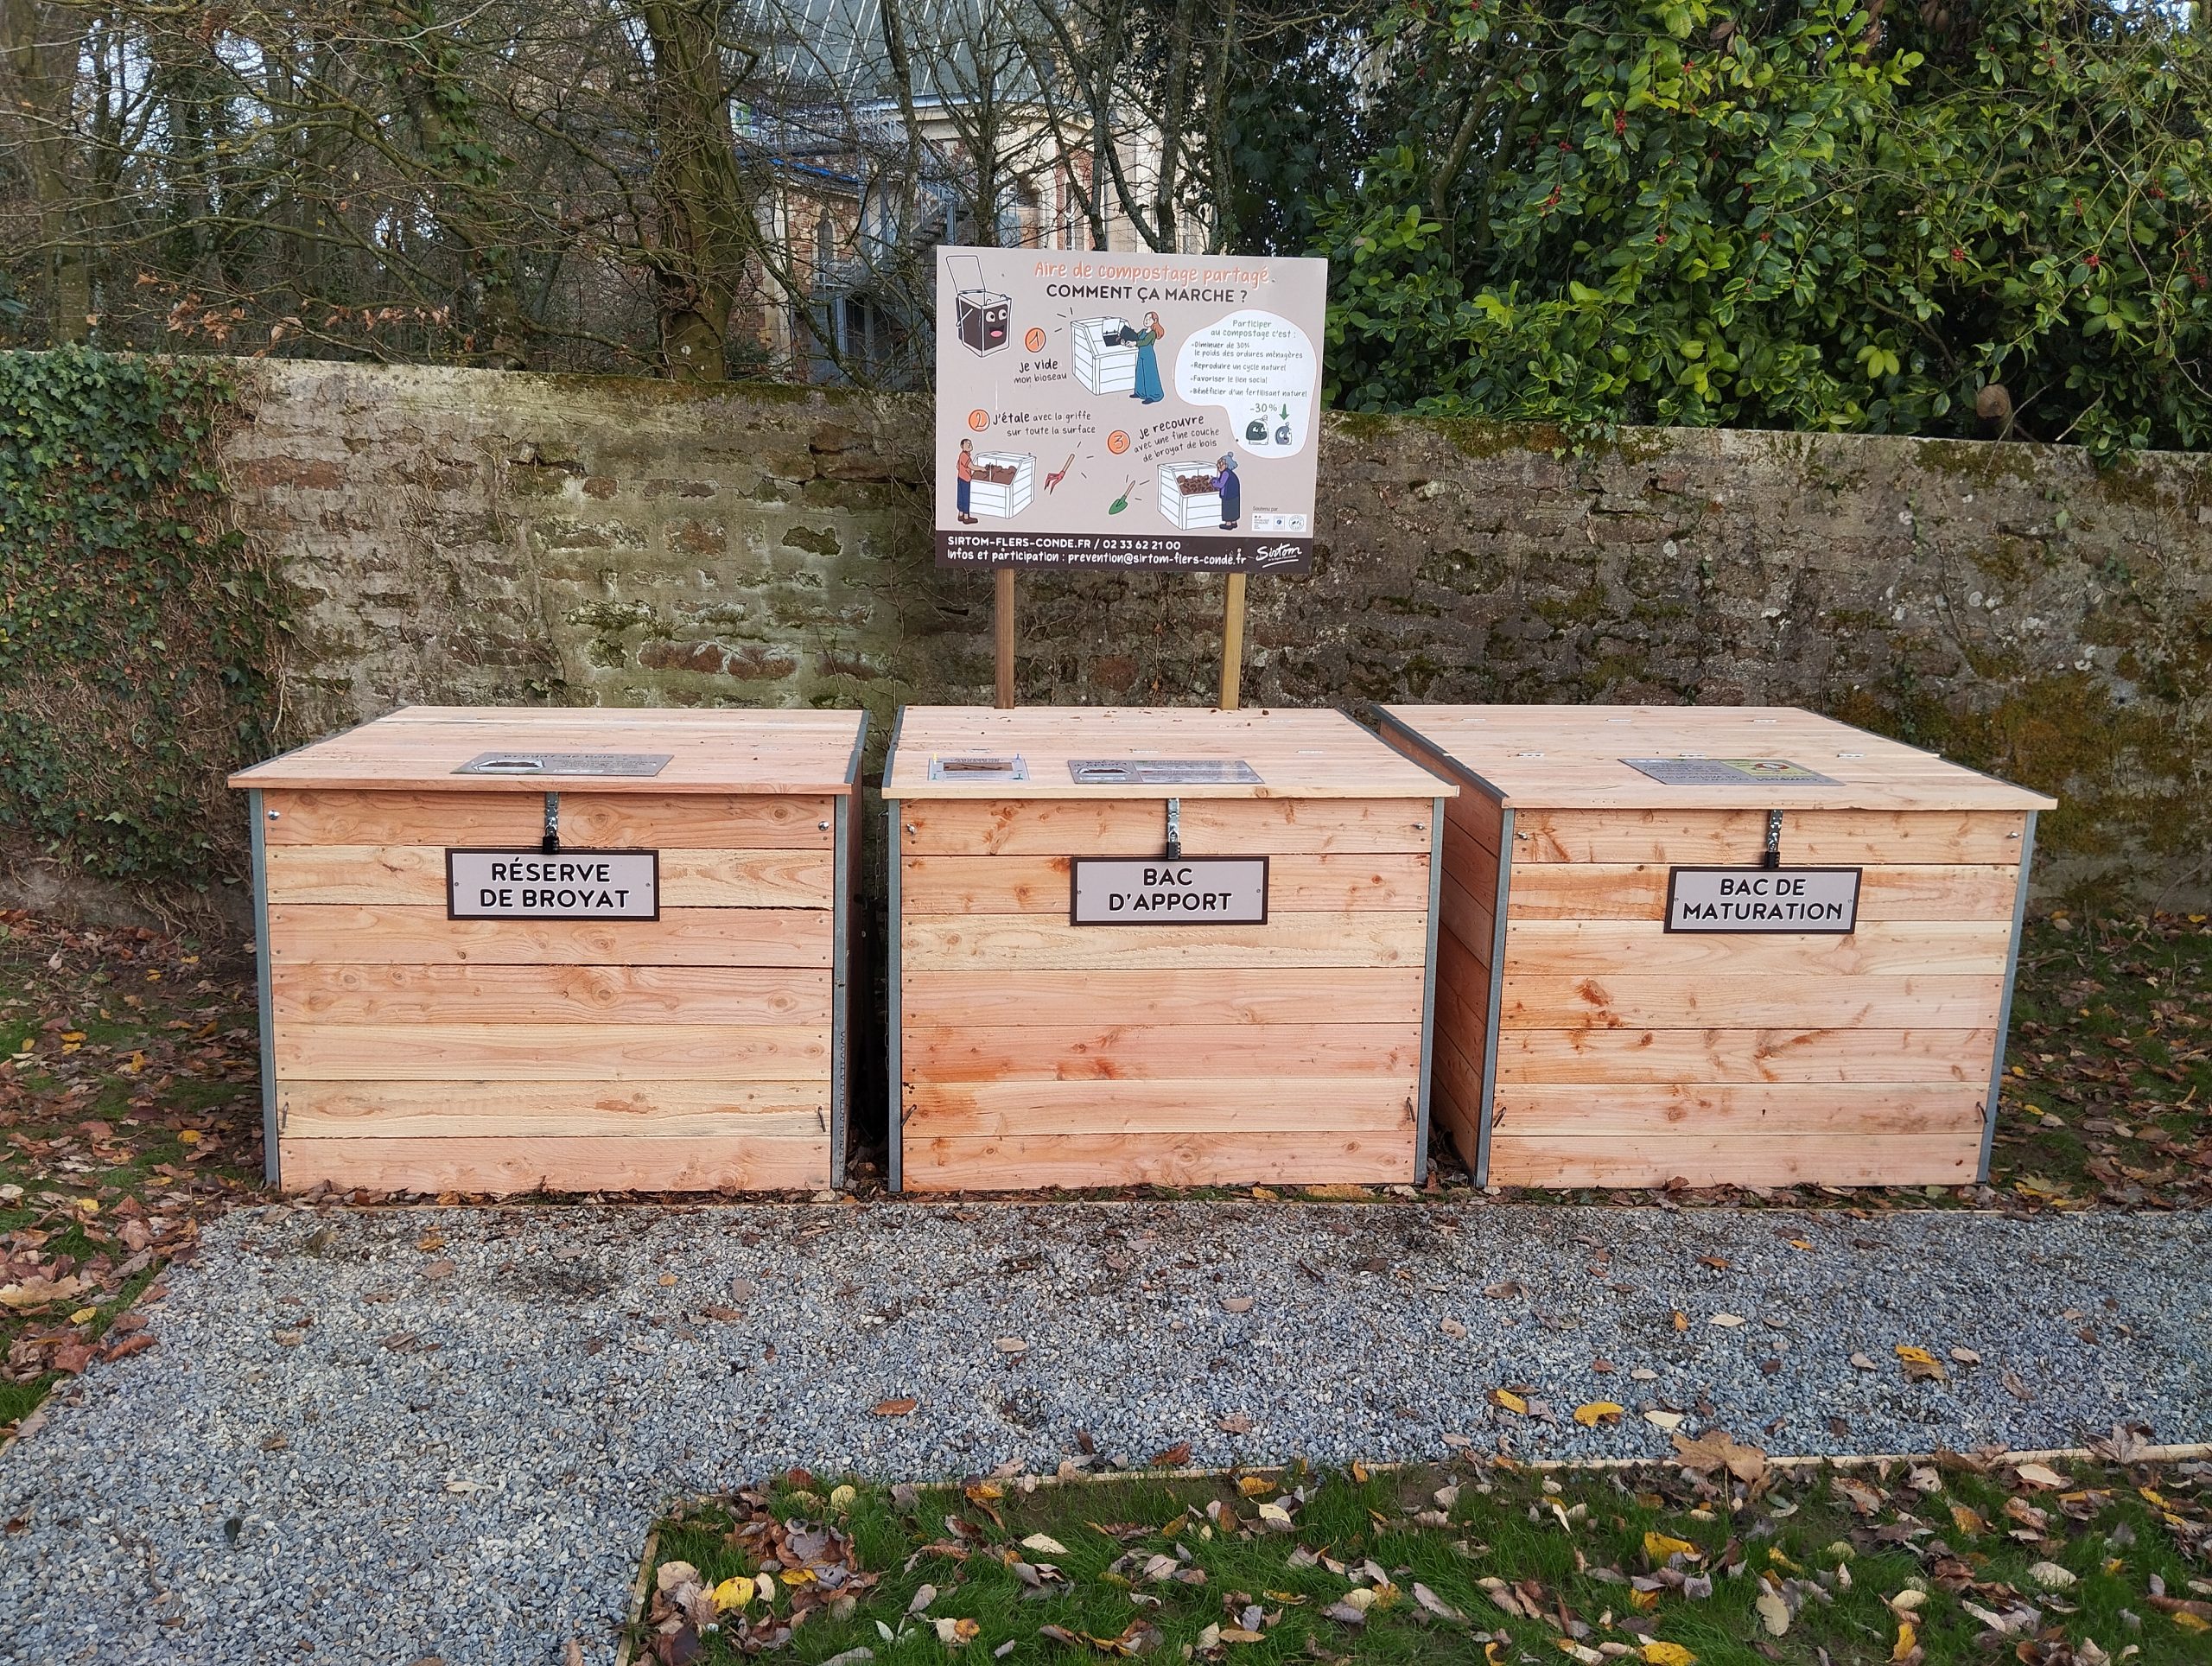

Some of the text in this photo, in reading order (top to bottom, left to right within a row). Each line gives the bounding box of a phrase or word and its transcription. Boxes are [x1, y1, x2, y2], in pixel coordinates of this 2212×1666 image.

[1035, 261, 1270, 290] Aire de compostage partagé
[1046, 283, 1248, 303] COMMENT ÇA MARCHE ?
[1232, 320, 1271, 330] Participer
[1223, 330, 1269, 340] compostage
[1019, 358, 1058, 373] Je vide
[1243, 364, 1260, 372] cycle
[1014, 372, 1067, 385] mon bioseau
[1249, 376, 1268, 385] social
[1246, 388, 1281, 397] fertilisant
[993, 411, 1030, 425] J'étale
[1055, 412, 1063, 421] la
[1065, 410, 1091, 423] griffe
[1007, 424, 1096, 437] sur toute la surface
[1139, 415, 1205, 440] Je recouvre
[1134, 427, 1220, 454] avec une fine couche
[1142, 439, 1217, 463] de broyat de bois
[947, 536, 1181, 550] SIRTOM-FLERS-CONDE.FR / 02 33 62 21 00
[947, 548, 974, 560] Infos
[977, 549, 989, 560] et
[991, 550, 1059, 563] participation
[1062, 553, 1065, 562] :
[491, 856, 611, 882] RÉSERVE
[1143, 868, 1193, 886] BAC
[1719, 878, 1807, 896] BAC DE
[480, 889, 630, 908] DE BROYAT
[1109, 892, 1233, 912] D'APPORT
[1682, 902, 1843, 921] MATURATION
